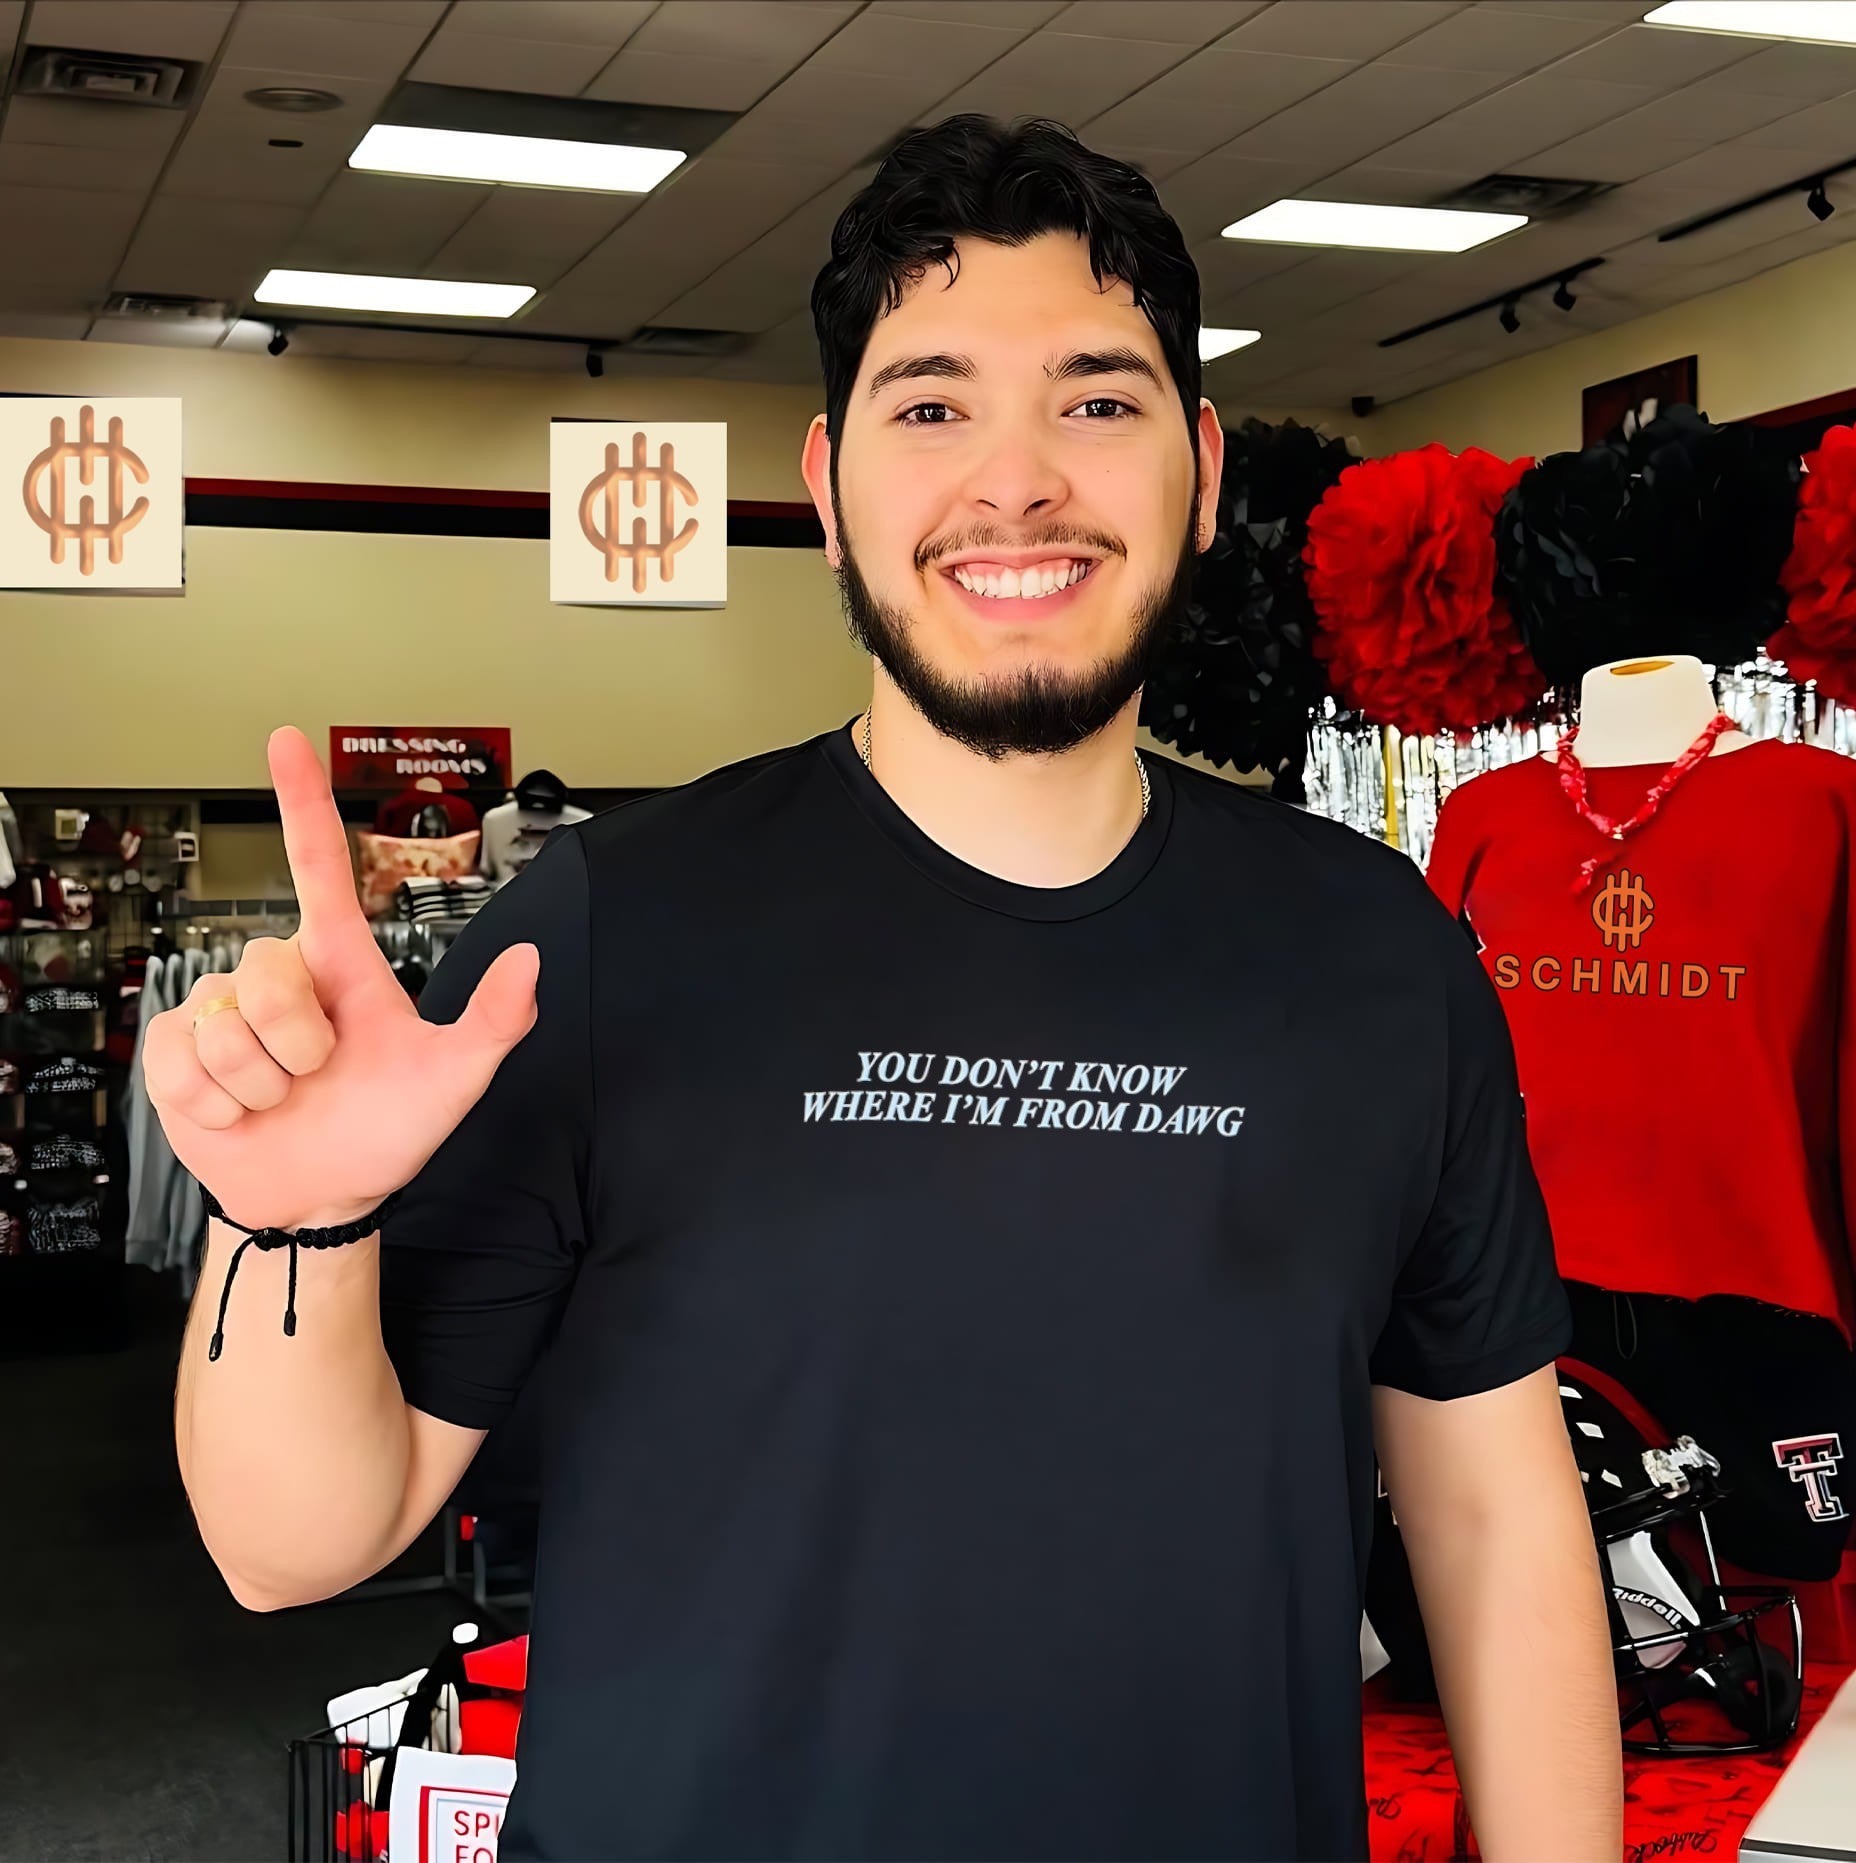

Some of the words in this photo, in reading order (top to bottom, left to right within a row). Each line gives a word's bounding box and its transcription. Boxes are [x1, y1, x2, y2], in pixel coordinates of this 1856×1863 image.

[396, 758, 487, 775] ROOMS
[1494, 954, 1747, 1000] SCHMIDT
[857, 1051, 936, 1083] YOU
[938, 1056, 1063, 1091] DON’T
[1066, 1062, 1188, 1096] KNOW
[803, 1091, 936, 1123] WHERE
[941, 1094, 1009, 1127] I’M
[1013, 1098, 1129, 1132] FROM
[1132, 1103, 1246, 1137] DAWG
